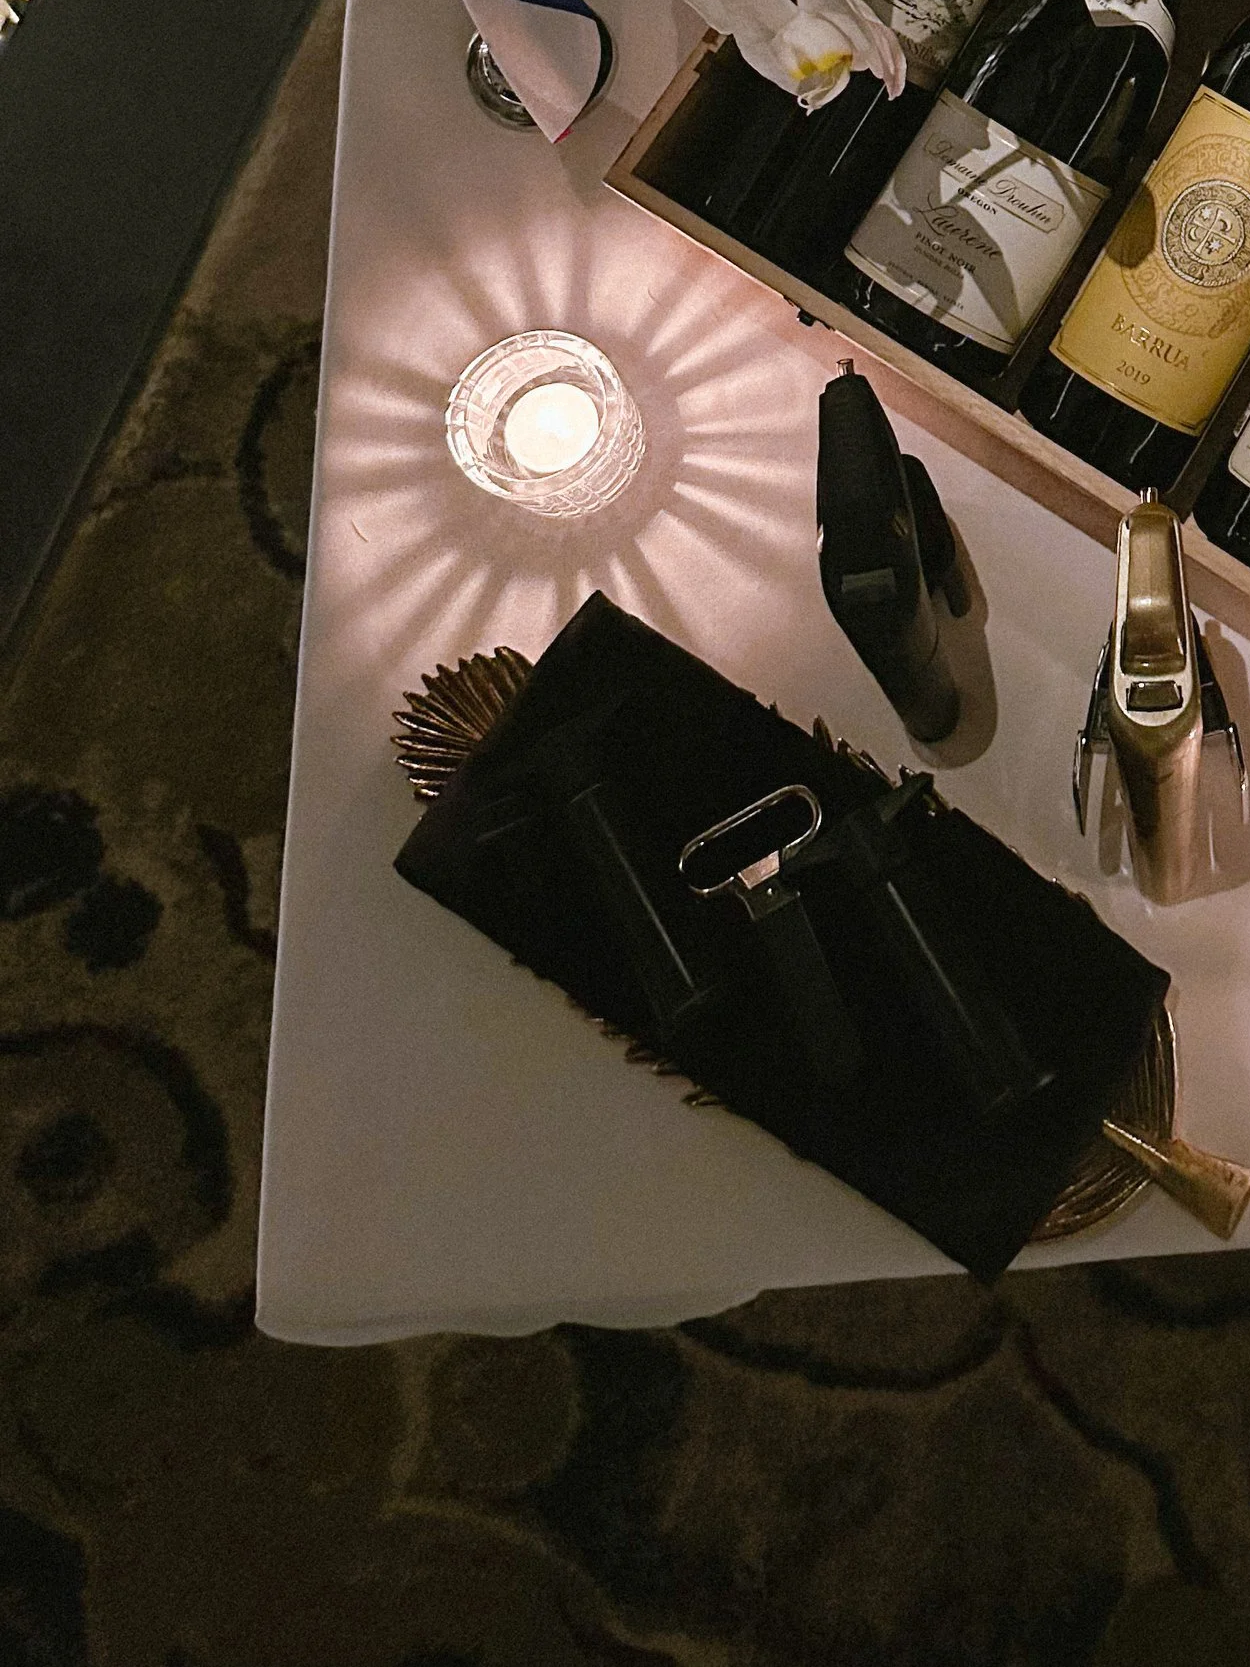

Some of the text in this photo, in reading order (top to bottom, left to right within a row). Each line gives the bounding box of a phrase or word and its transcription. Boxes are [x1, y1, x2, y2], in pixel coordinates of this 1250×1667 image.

[957, 187, 997, 215] OREGON
[989, 176, 1052, 225] Drouhin
[915, 232, 977, 274] PINOT NOIR
[1111, 313, 1191, 372] BARRUA
[1115, 359, 1152, 386] 2019
